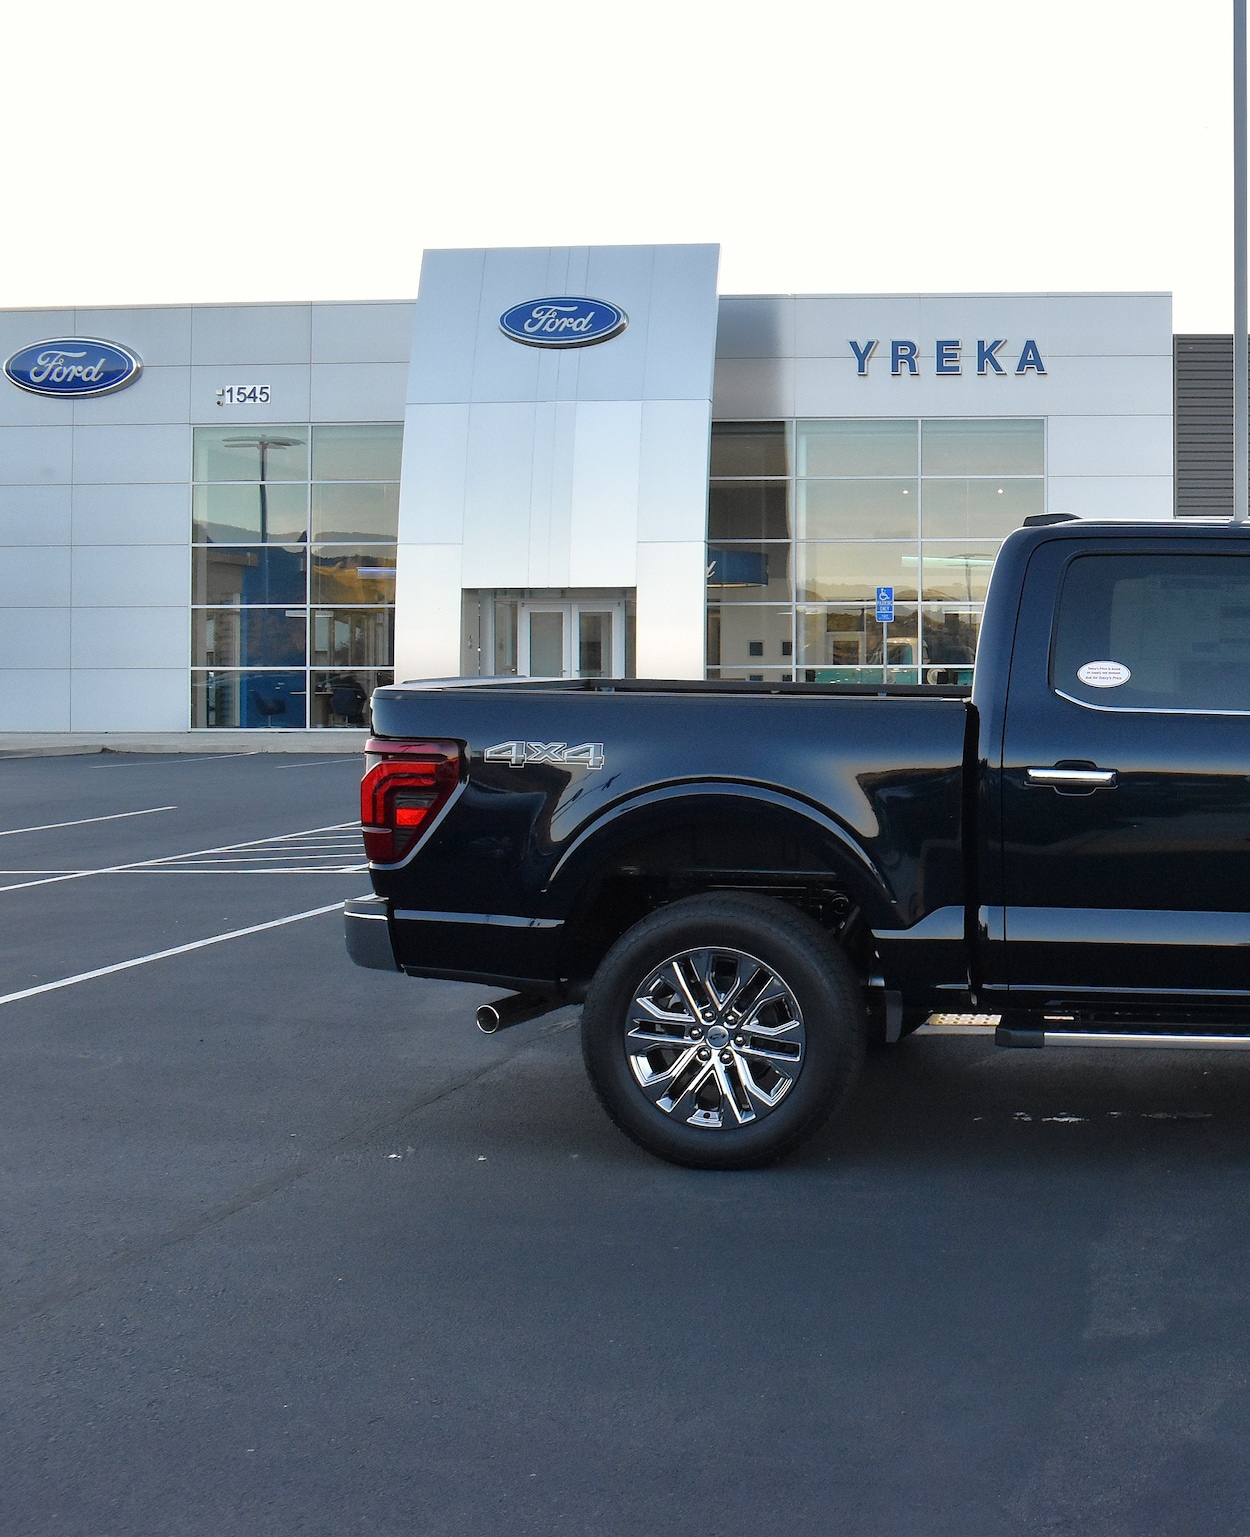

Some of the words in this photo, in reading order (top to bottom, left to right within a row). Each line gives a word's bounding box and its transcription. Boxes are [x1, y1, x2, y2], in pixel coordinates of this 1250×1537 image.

[523, 305, 596, 333] Ford
[29, 350, 107, 383] Ford
[848, 338, 1048, 376] YREKA
[226, 386, 270, 403] 1545
